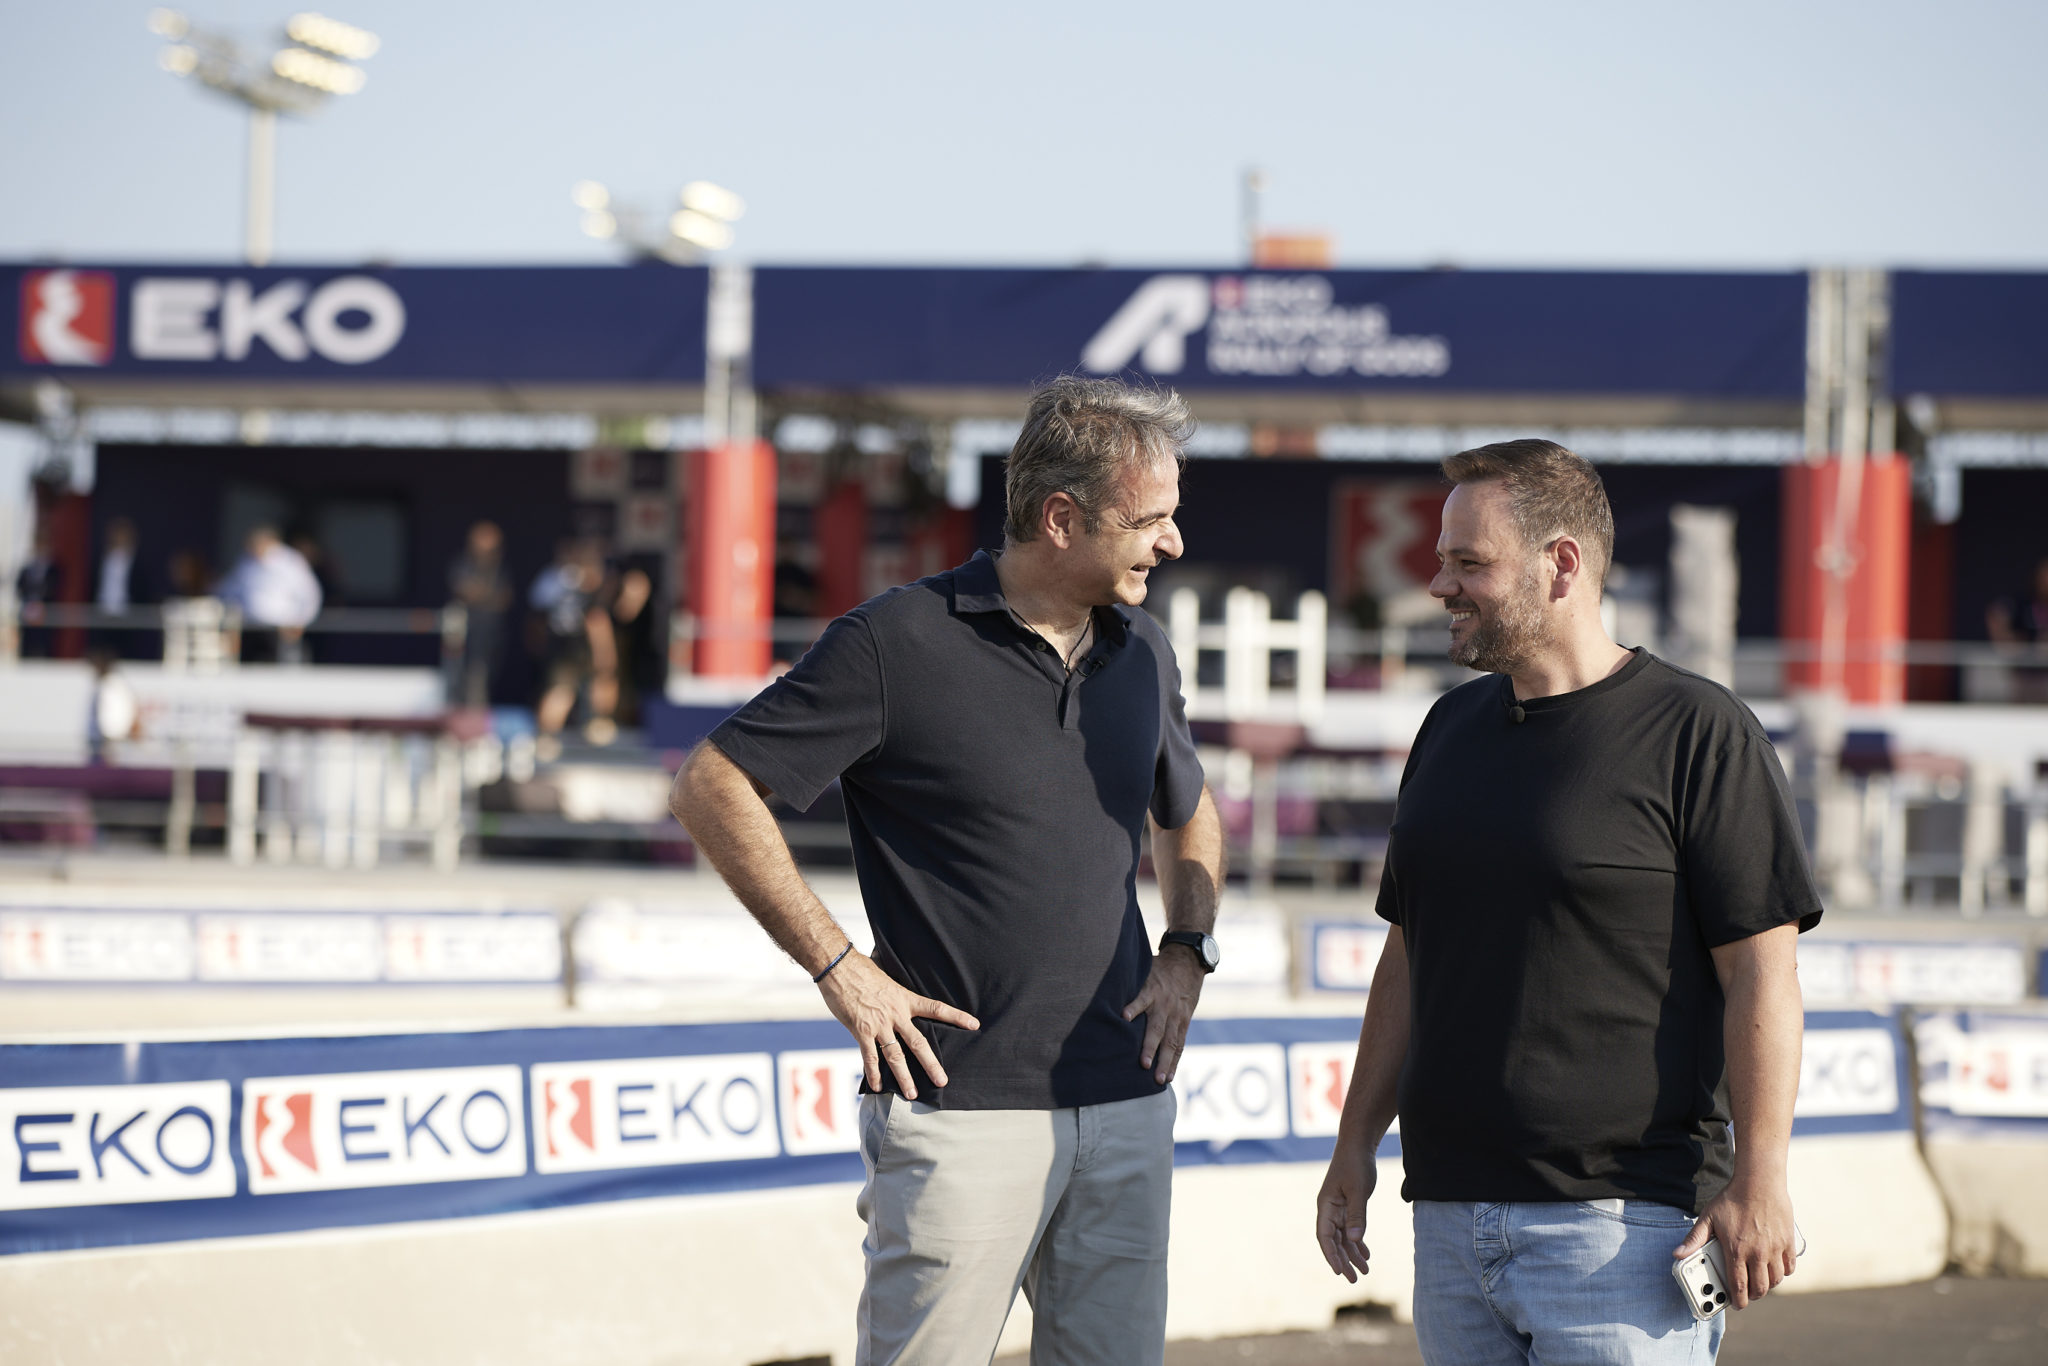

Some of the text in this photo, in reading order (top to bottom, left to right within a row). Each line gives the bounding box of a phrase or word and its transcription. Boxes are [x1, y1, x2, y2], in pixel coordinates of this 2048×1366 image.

[132, 277, 405, 365] EKO
[1179, 1065, 1275, 1118] KO
[1799, 1049, 1881, 1098] KO
[14, 1105, 215, 1183] EKO
[339, 1089, 512, 1163] EKO
[617, 1076, 763, 1143] EKO
